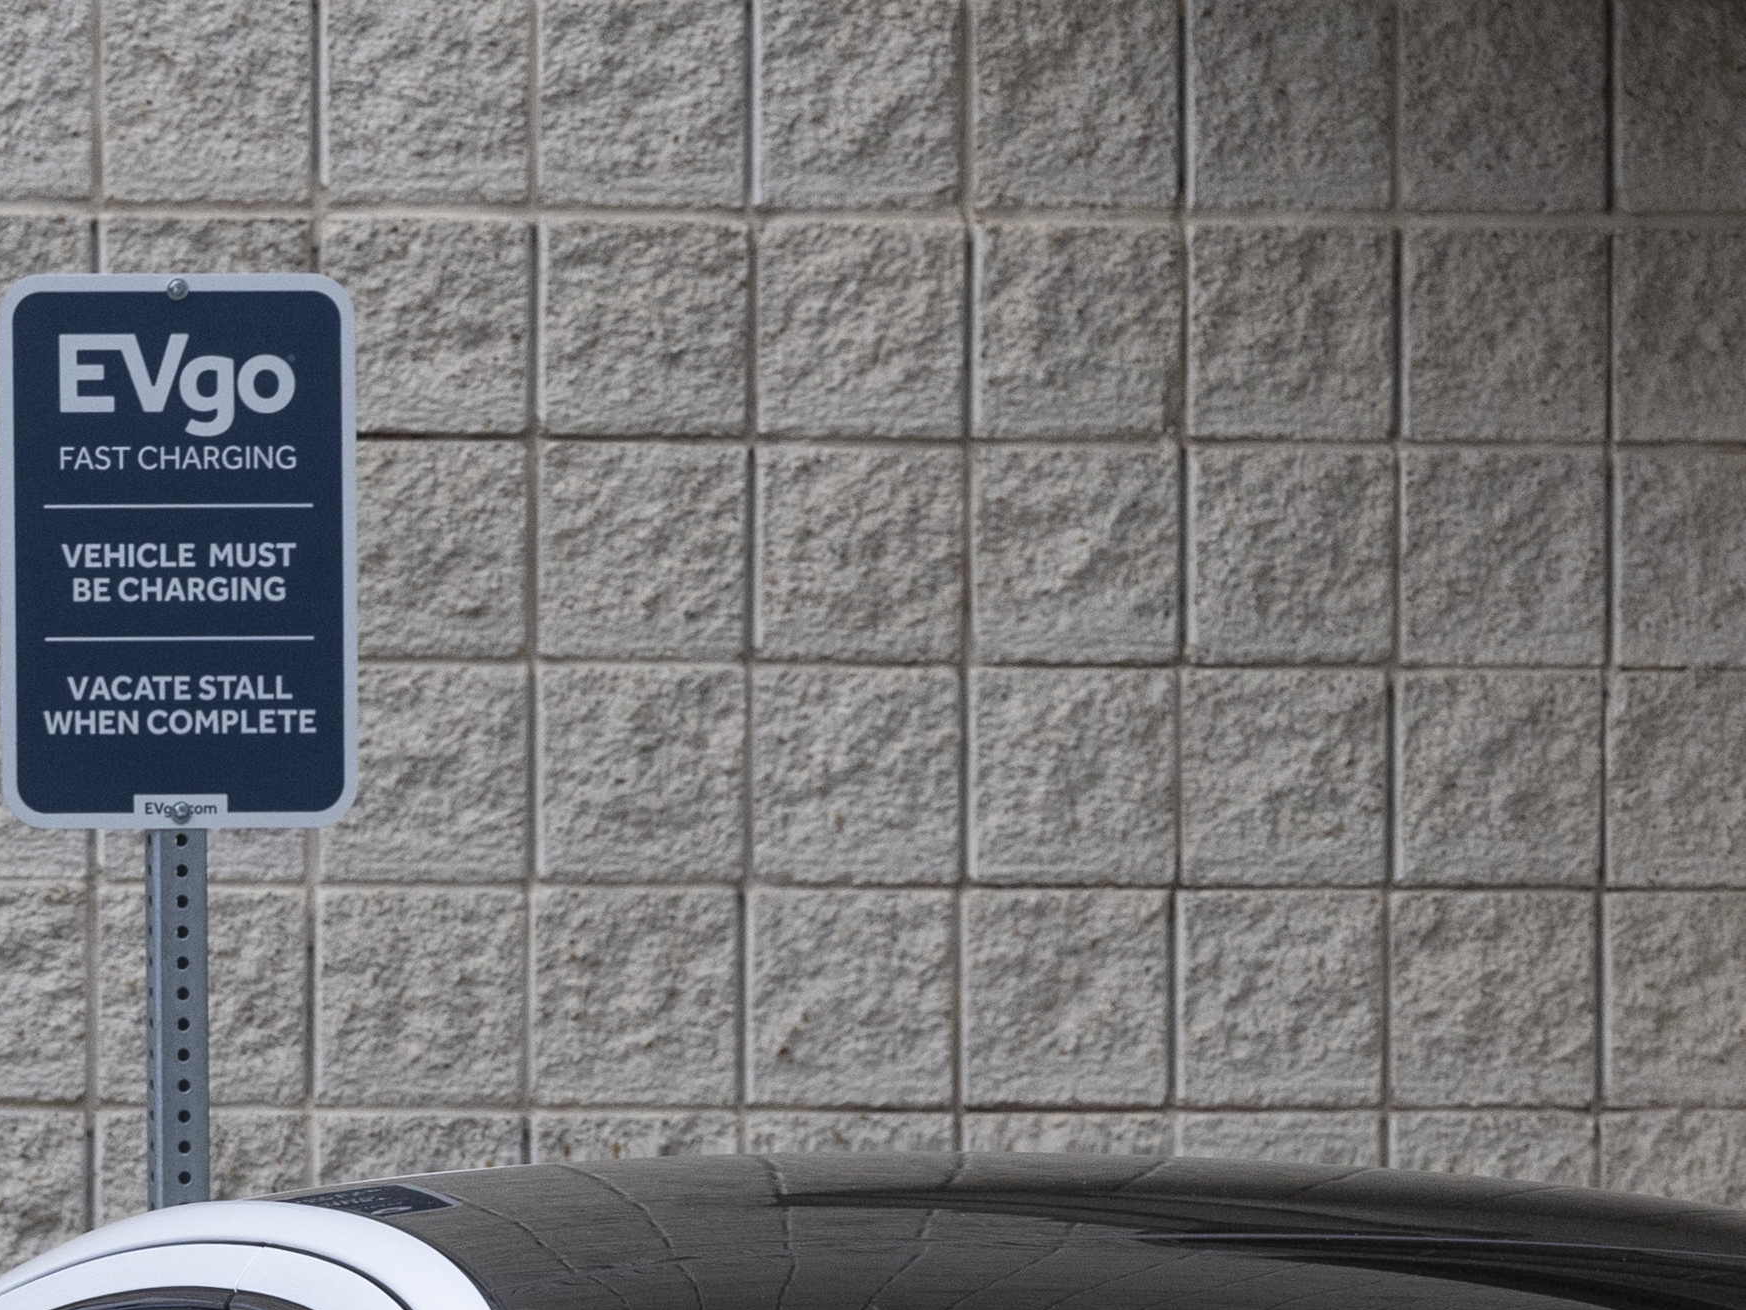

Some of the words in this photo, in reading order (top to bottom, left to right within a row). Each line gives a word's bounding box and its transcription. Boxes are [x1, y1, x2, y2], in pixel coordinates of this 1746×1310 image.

[58, 333, 295, 437] EVgo
[59, 446, 131, 471] FAST
[138, 445, 297, 471] CHARGING
[61, 542, 196, 569] VEHICLE
[209, 542, 297, 568] MUST
[72, 577, 111, 602] BE
[118, 576, 286, 602] CHARGING
[67, 675, 192, 701] VACATE
[199, 674, 293, 700] STALL
[43, 710, 139, 735] WHEN
[146, 709, 317, 735] COMPLETE
[145, 802, 217, 818] EVgcom
